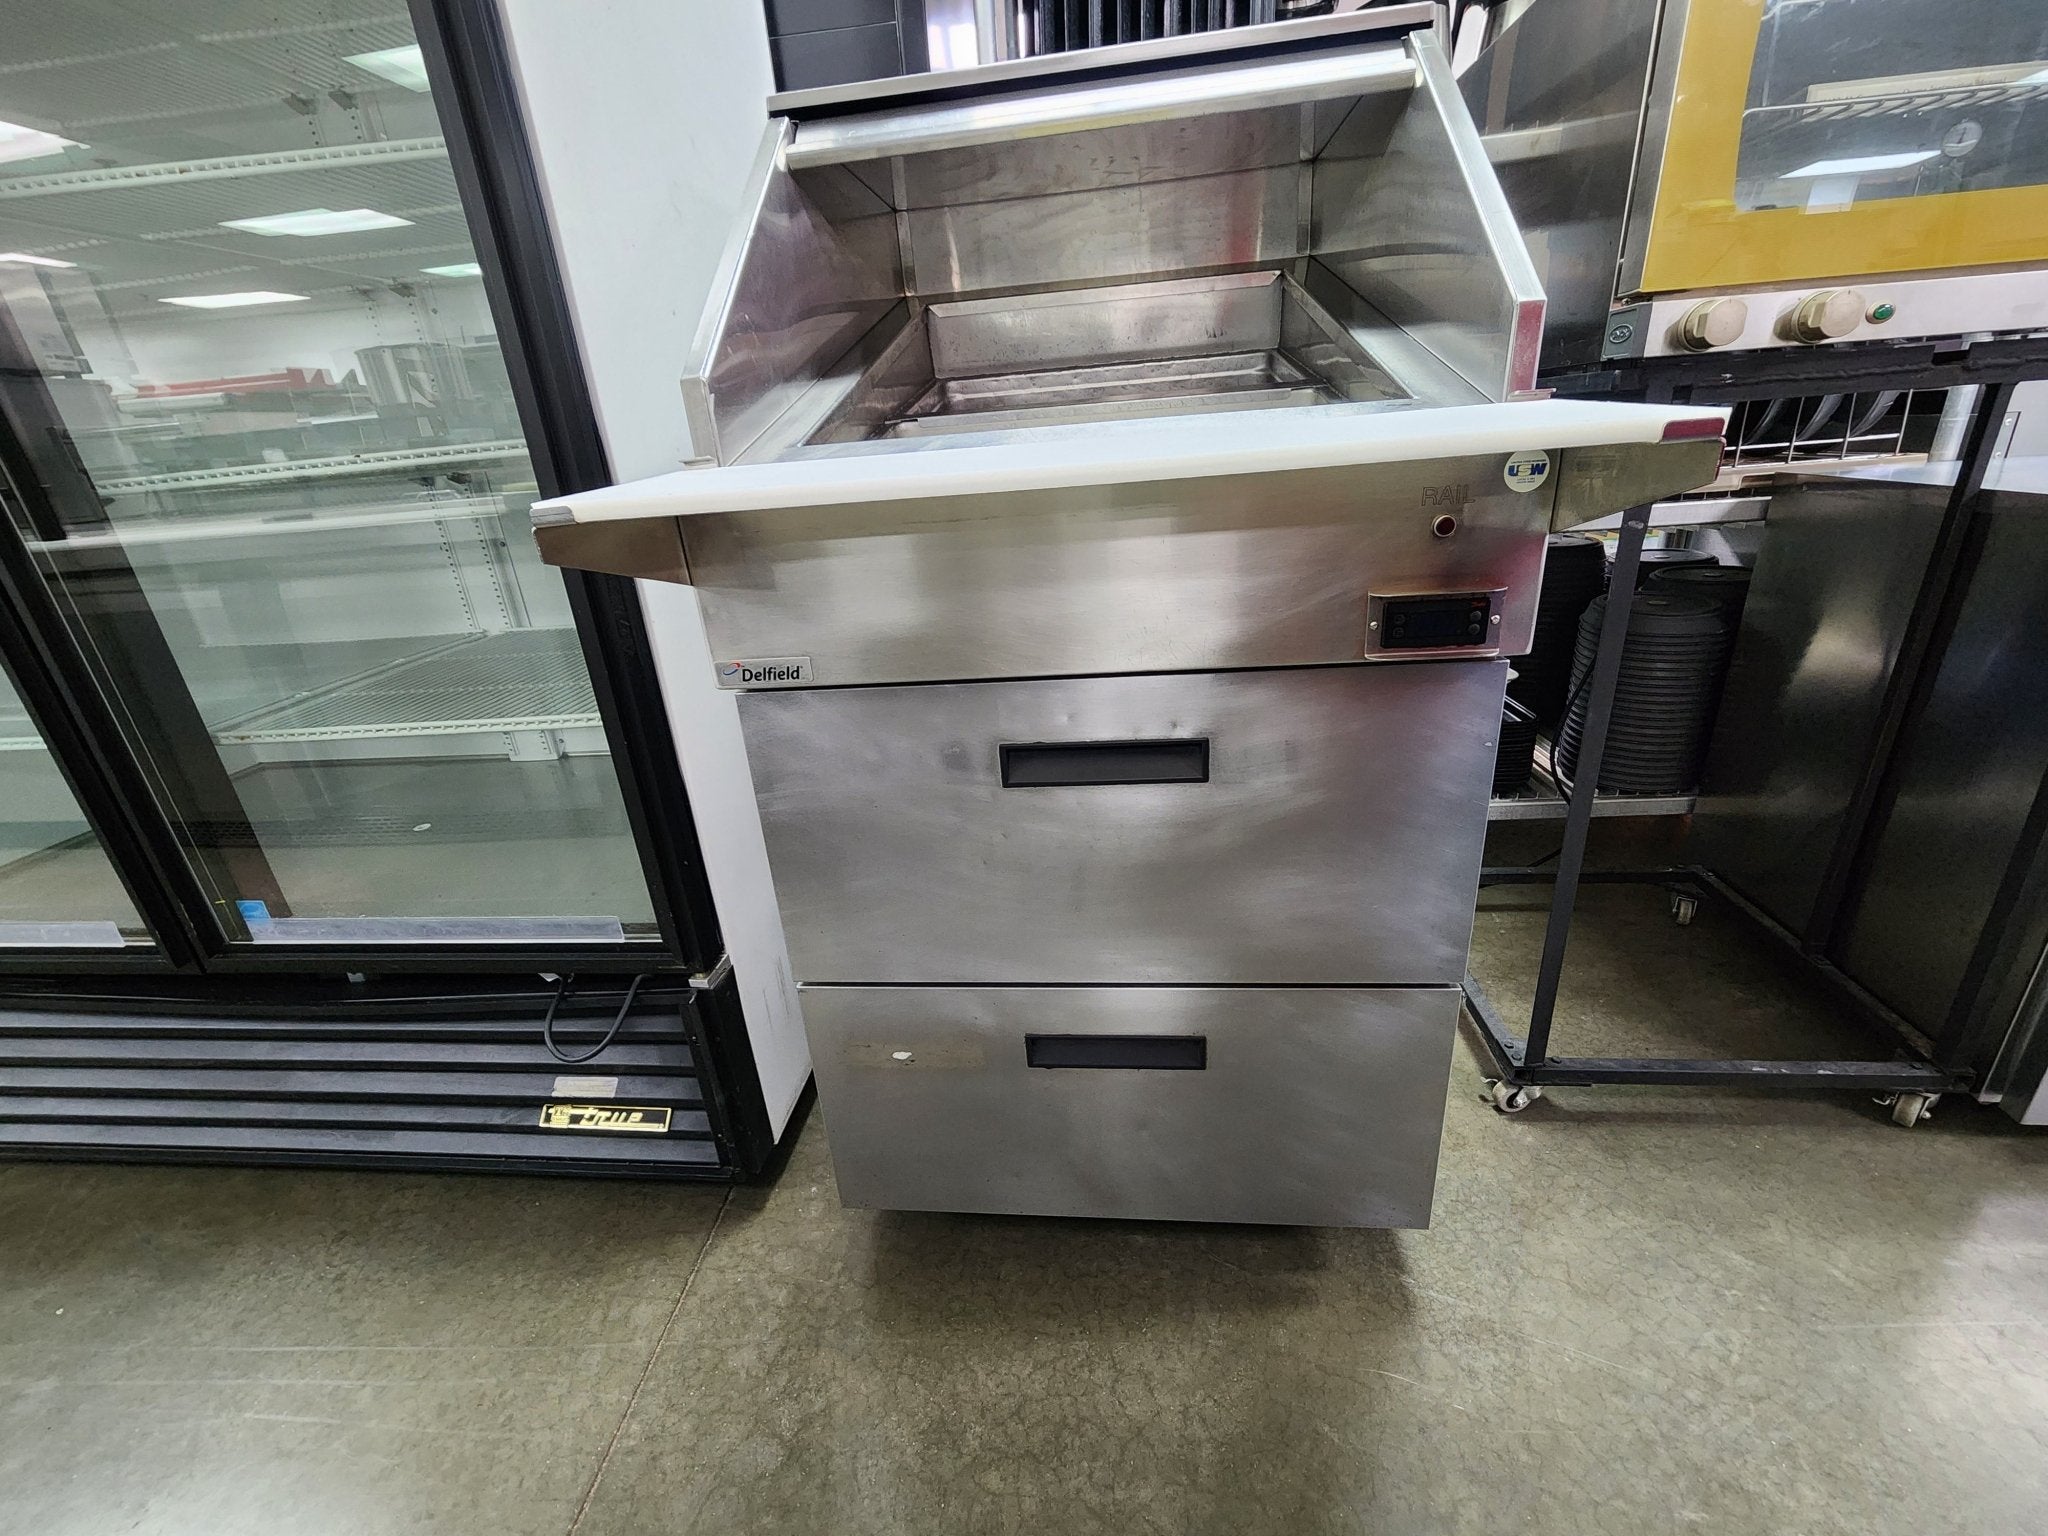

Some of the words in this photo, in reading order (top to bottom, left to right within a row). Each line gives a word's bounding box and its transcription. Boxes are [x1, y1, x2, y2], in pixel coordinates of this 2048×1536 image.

[1508, 463, 1548, 476] USW
[1421, 485, 1476, 506] RAIL
[742, 665, 800, 682] Delfield
